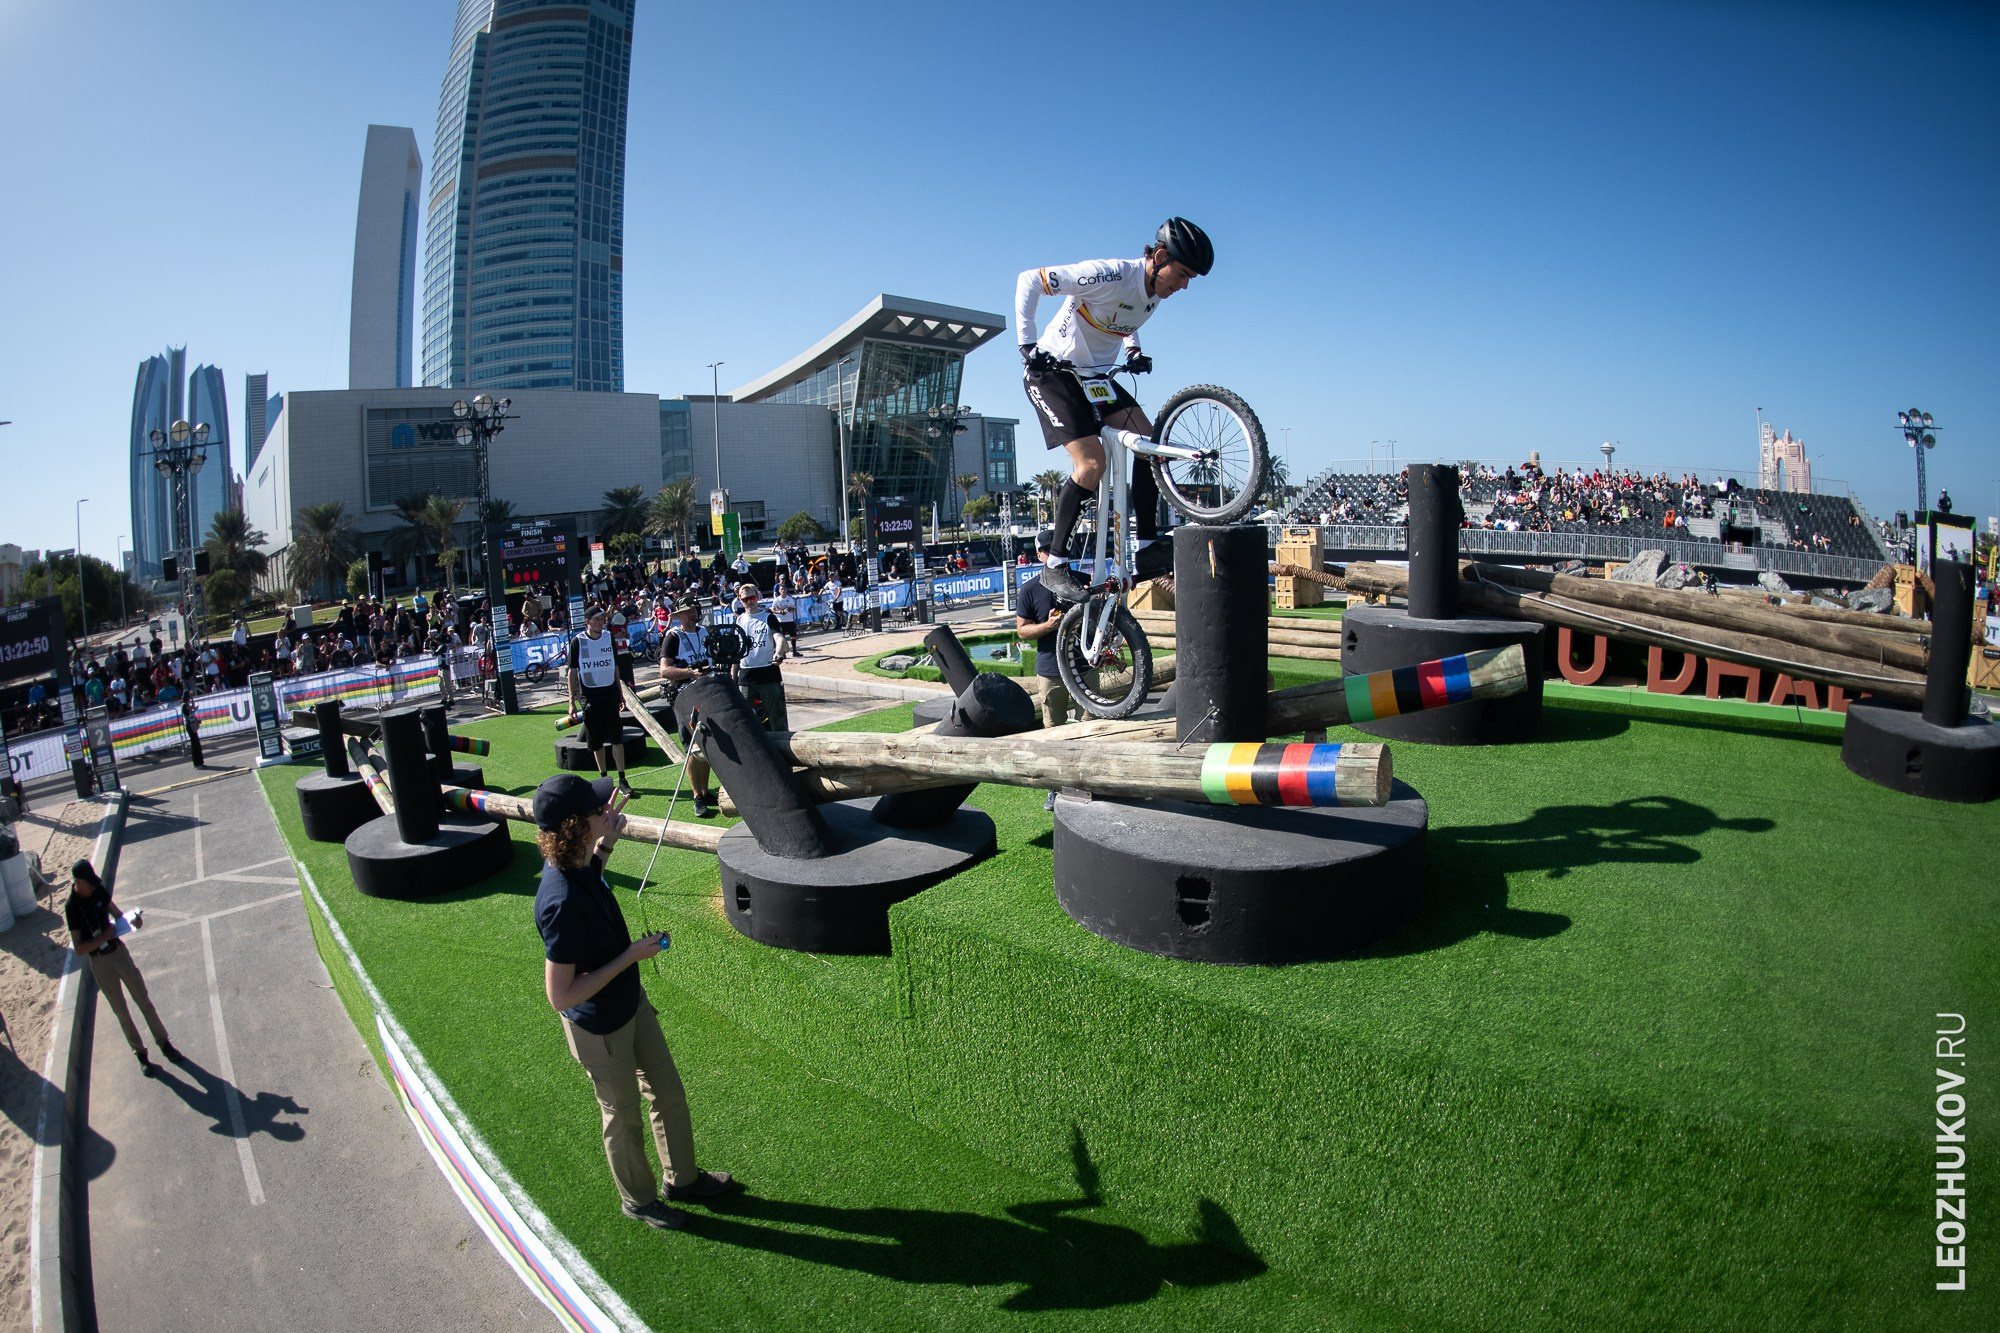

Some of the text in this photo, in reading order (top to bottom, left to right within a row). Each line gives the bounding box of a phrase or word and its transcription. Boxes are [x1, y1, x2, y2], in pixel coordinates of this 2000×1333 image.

[1077, 271, 1122, 286] Cofidis
[1090, 386, 1109, 398] 103
[880, 519, 913, 532] 13:22:50
[521, 528, 543, 537] FINISH
[1009, 573, 1014, 583] 5
[934, 577, 991, 597] SHIMANO
[7, 611, 28, 622] FINISH
[702, 615, 711, 626] 4
[752, 640, 767, 648] OST
[582, 660, 611, 670] TV HOST
[253, 686, 272, 694] START
[259, 694, 270, 710] 3
[95, 729, 106, 746] 2
[303, 741, 320, 752] UC
